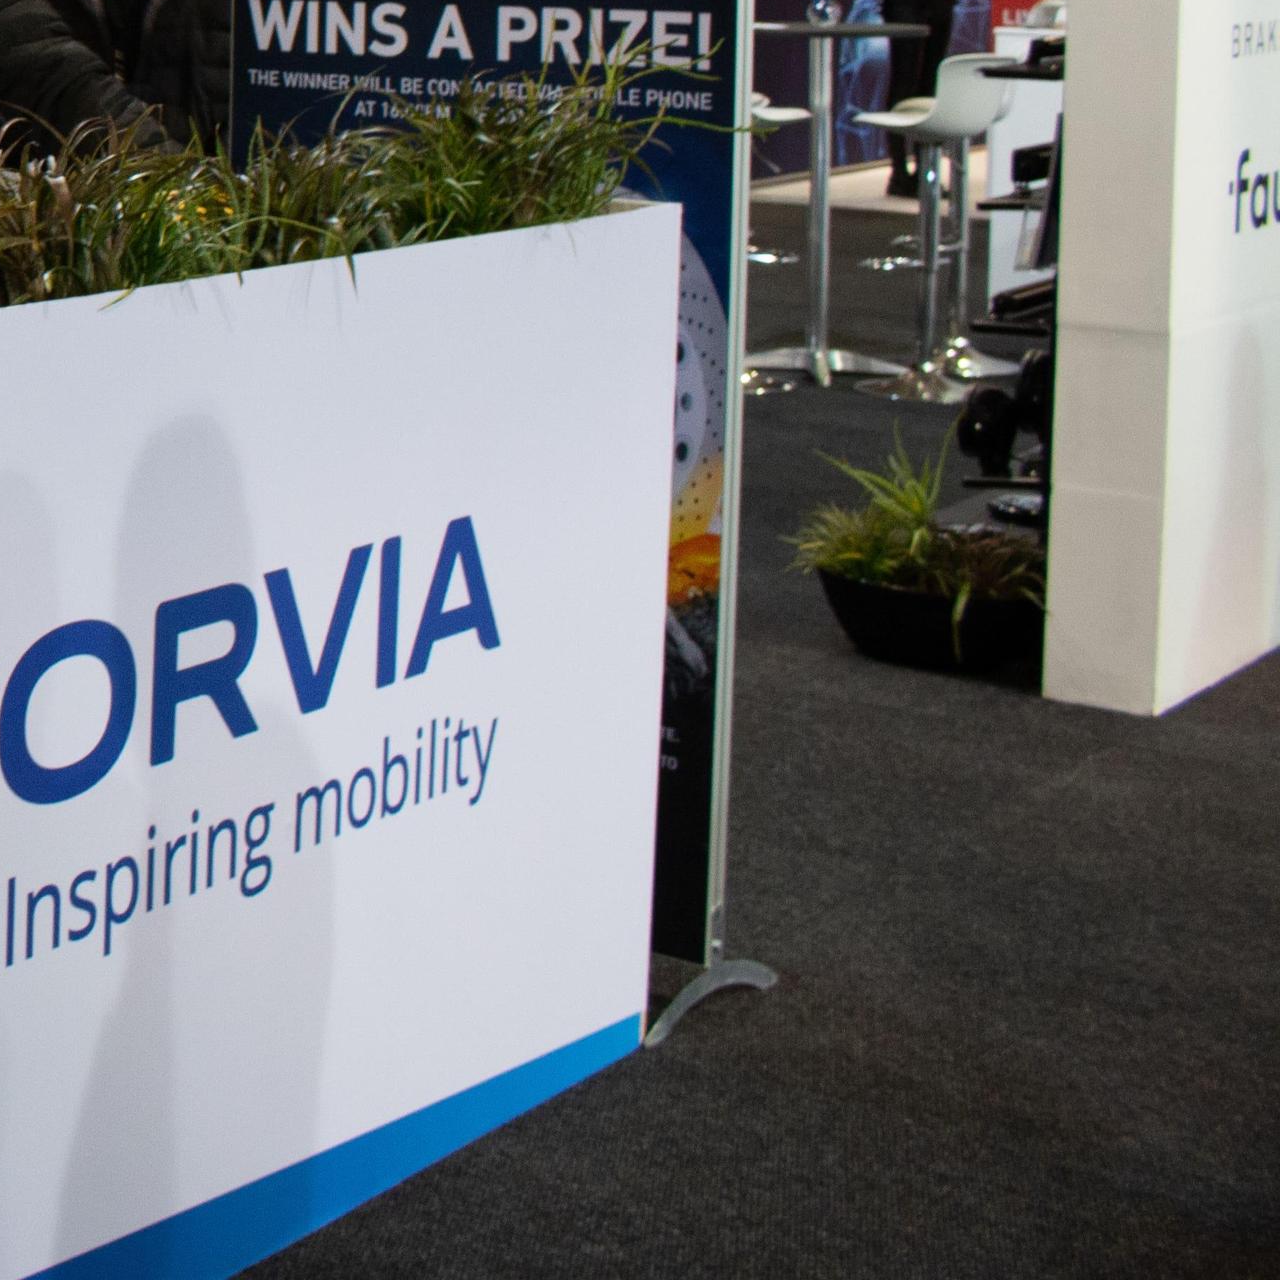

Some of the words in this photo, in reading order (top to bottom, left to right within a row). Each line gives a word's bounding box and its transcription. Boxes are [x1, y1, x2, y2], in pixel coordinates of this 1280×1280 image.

[427, 4, 474, 61] A
[497, 6, 714, 71] PRIZE!
[248, 69, 280, 87] THE
[283, 71, 350, 91] WINNER
[354, 75, 396, 94] WILL
[400, 77, 423, 95] BE
[427, 78, 527, 100] CONACTED
[646, 88, 713, 111] PHONE
[354, 100, 376, 117] AT
[5, 801, 276, 968] Inspiring
[293, 715, 499, 854] mobility
